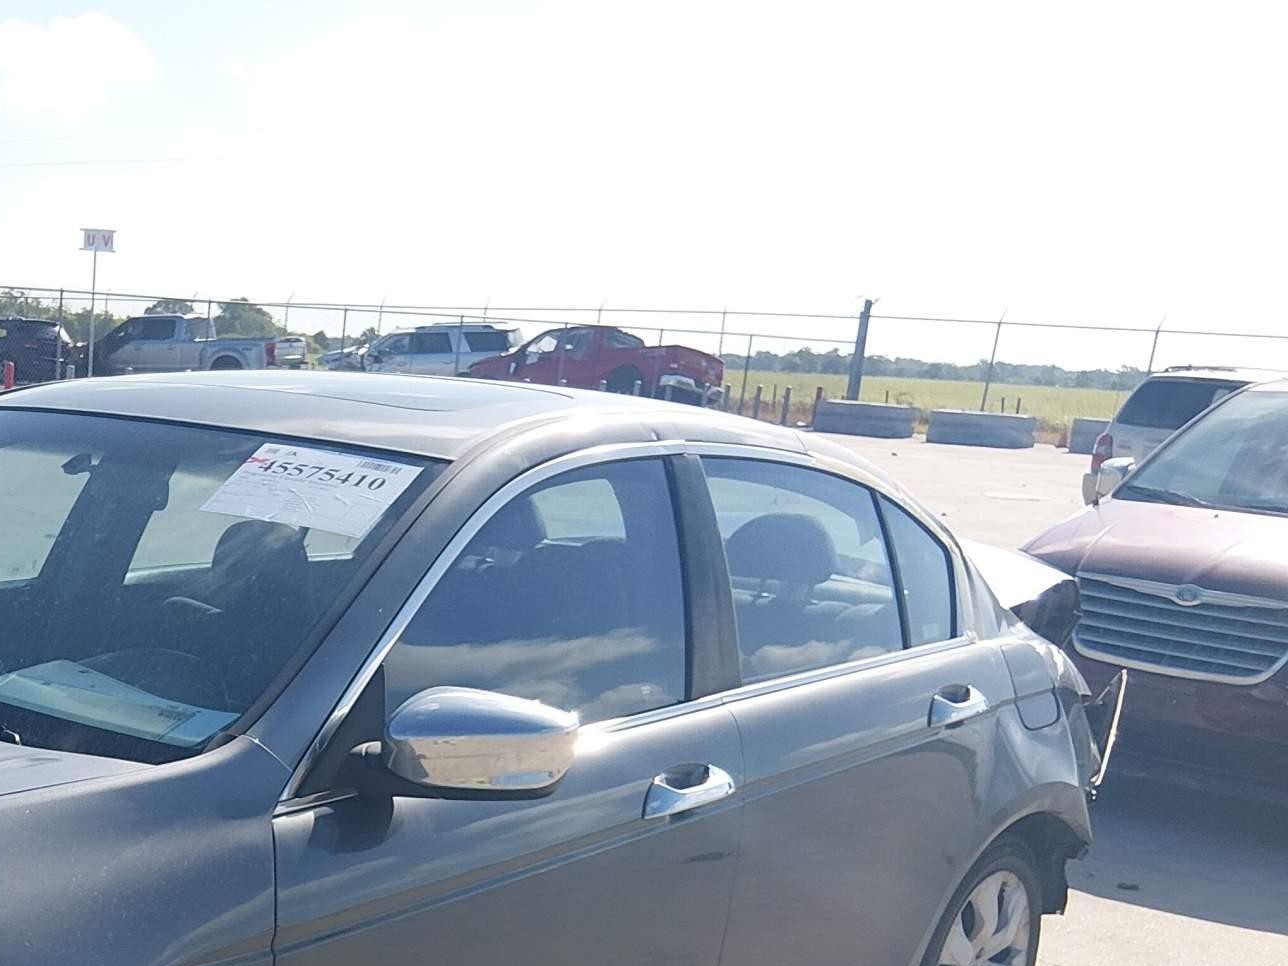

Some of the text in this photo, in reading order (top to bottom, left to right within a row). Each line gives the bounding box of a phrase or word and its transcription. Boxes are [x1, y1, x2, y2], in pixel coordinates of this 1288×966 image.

[87, 233, 111, 248] U V
[258, 459, 387, 492] 45575410
